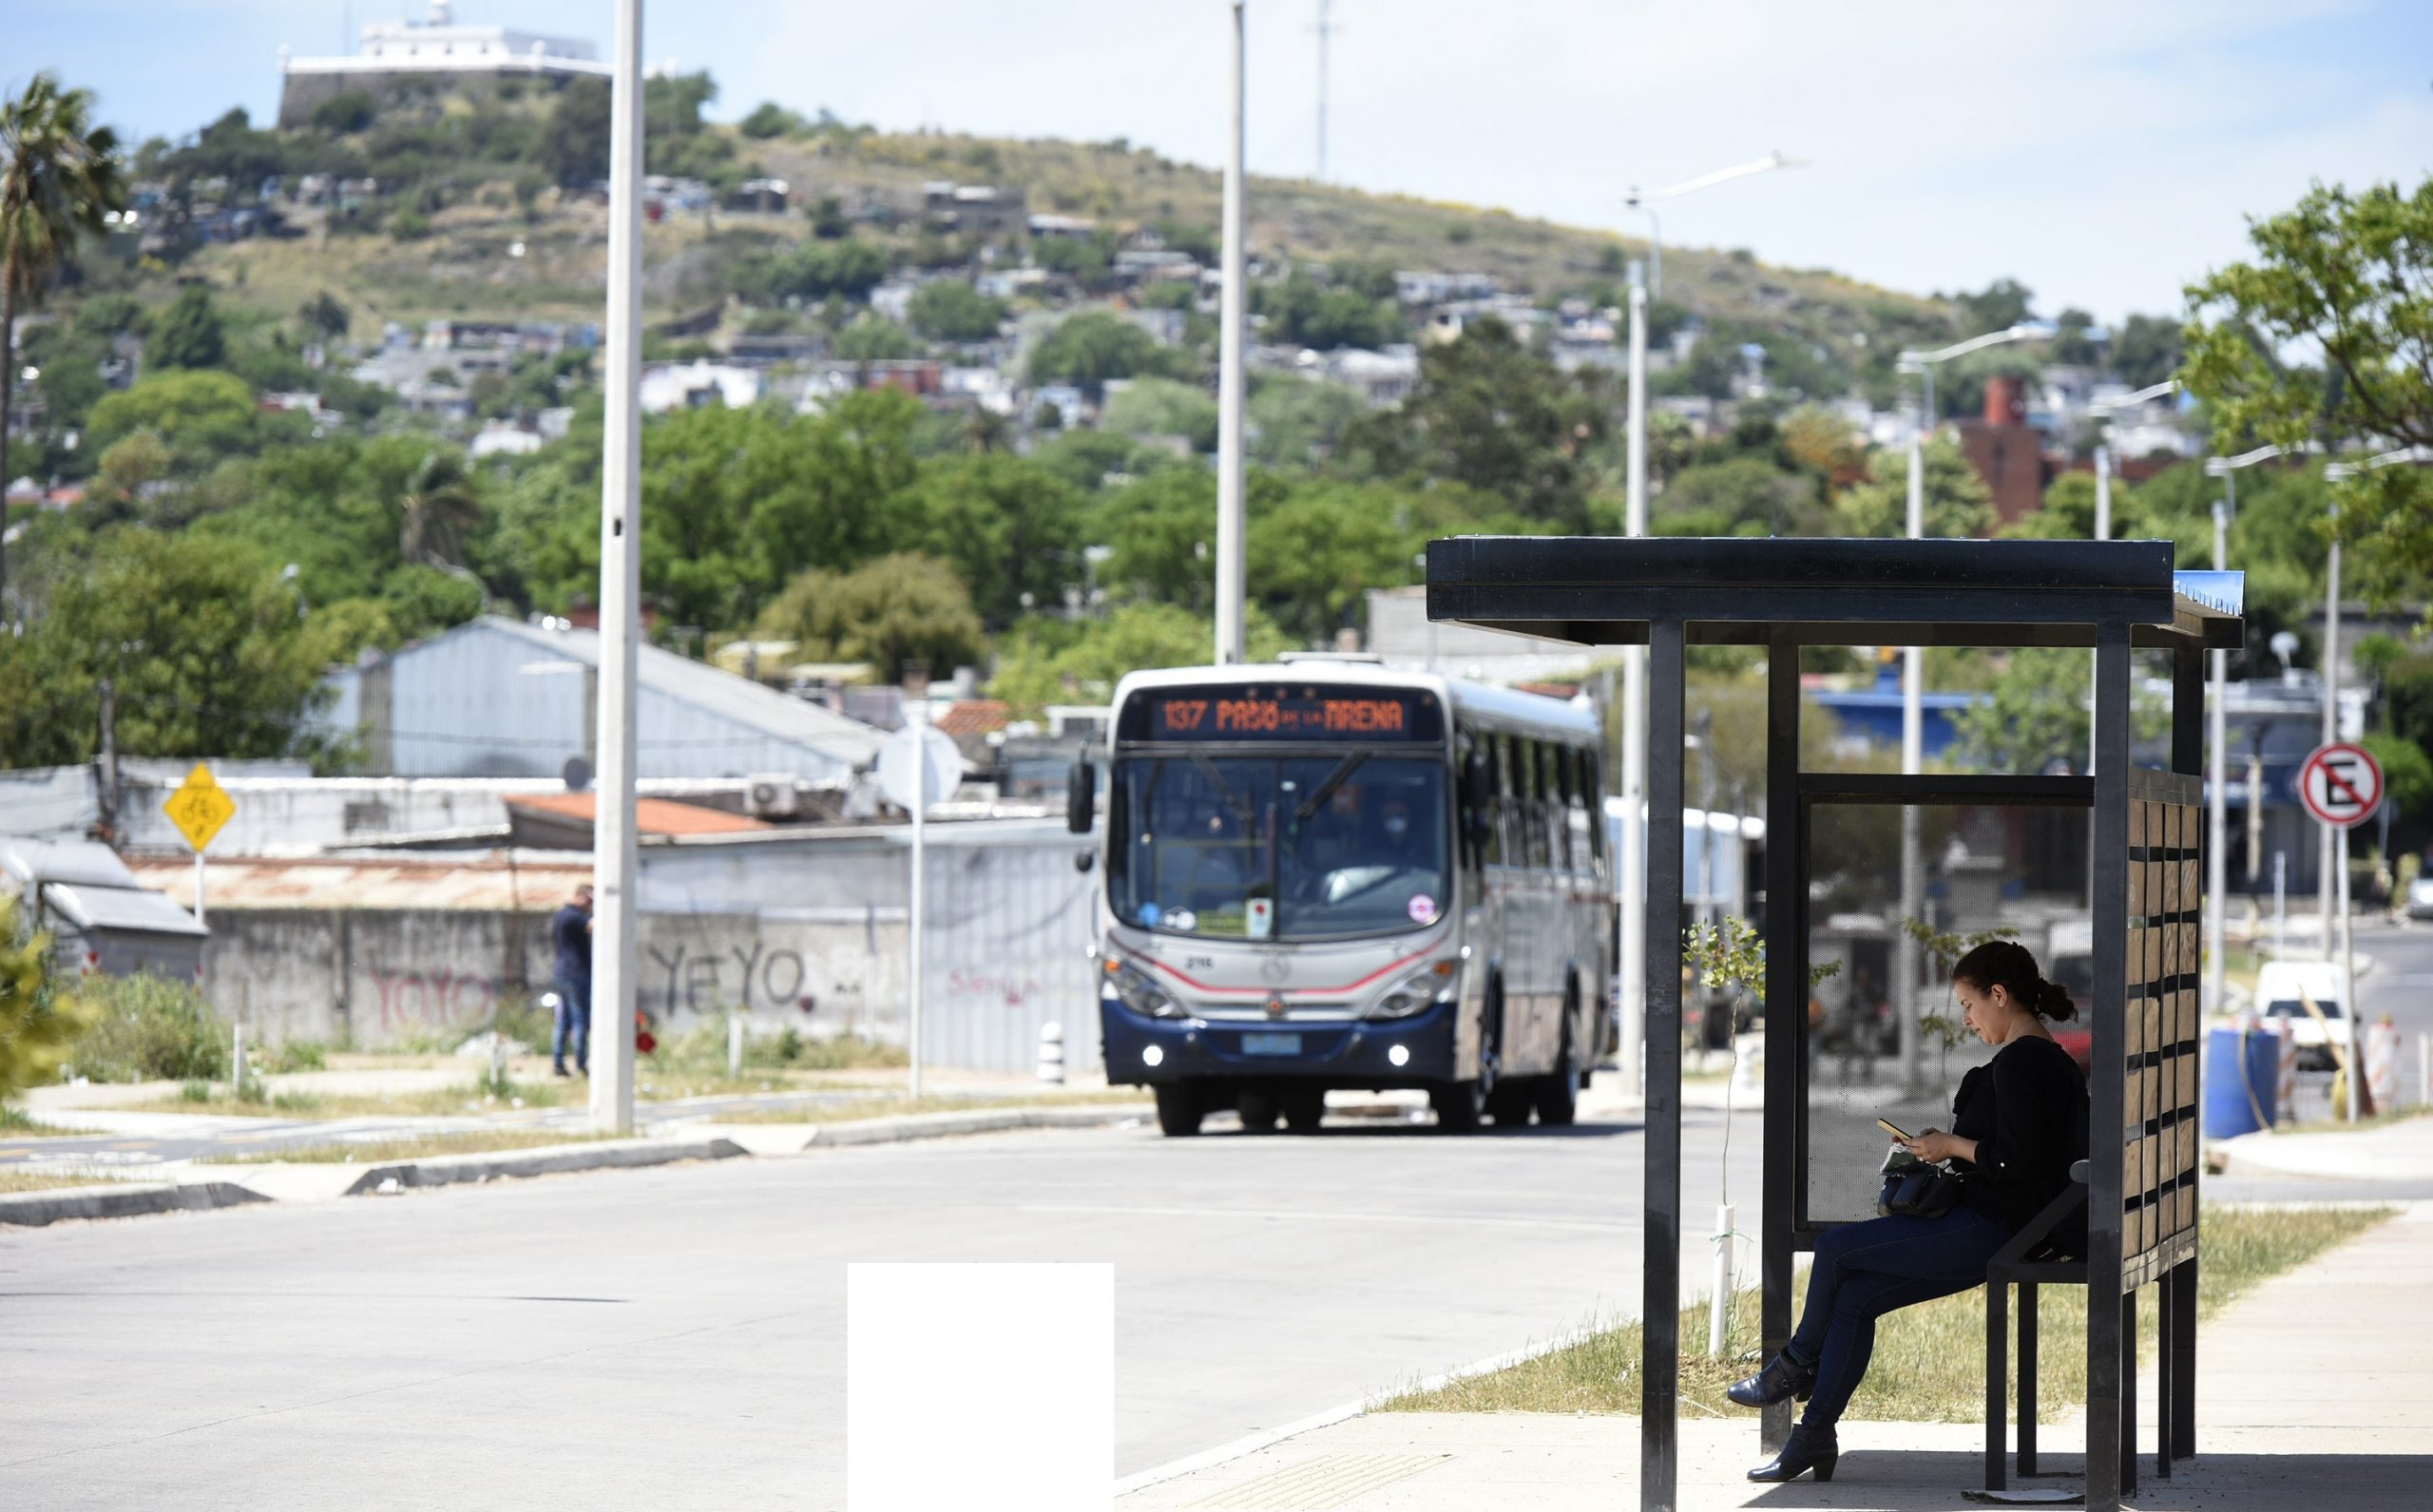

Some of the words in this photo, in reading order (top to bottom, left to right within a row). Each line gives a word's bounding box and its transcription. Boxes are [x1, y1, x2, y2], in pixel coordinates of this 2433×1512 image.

[1163, 699, 1208, 731] 137
[1216, 699, 1278, 731] PASO
[1324, 699, 1404, 731] ARENA
[2327, 760, 2361, 805] E
